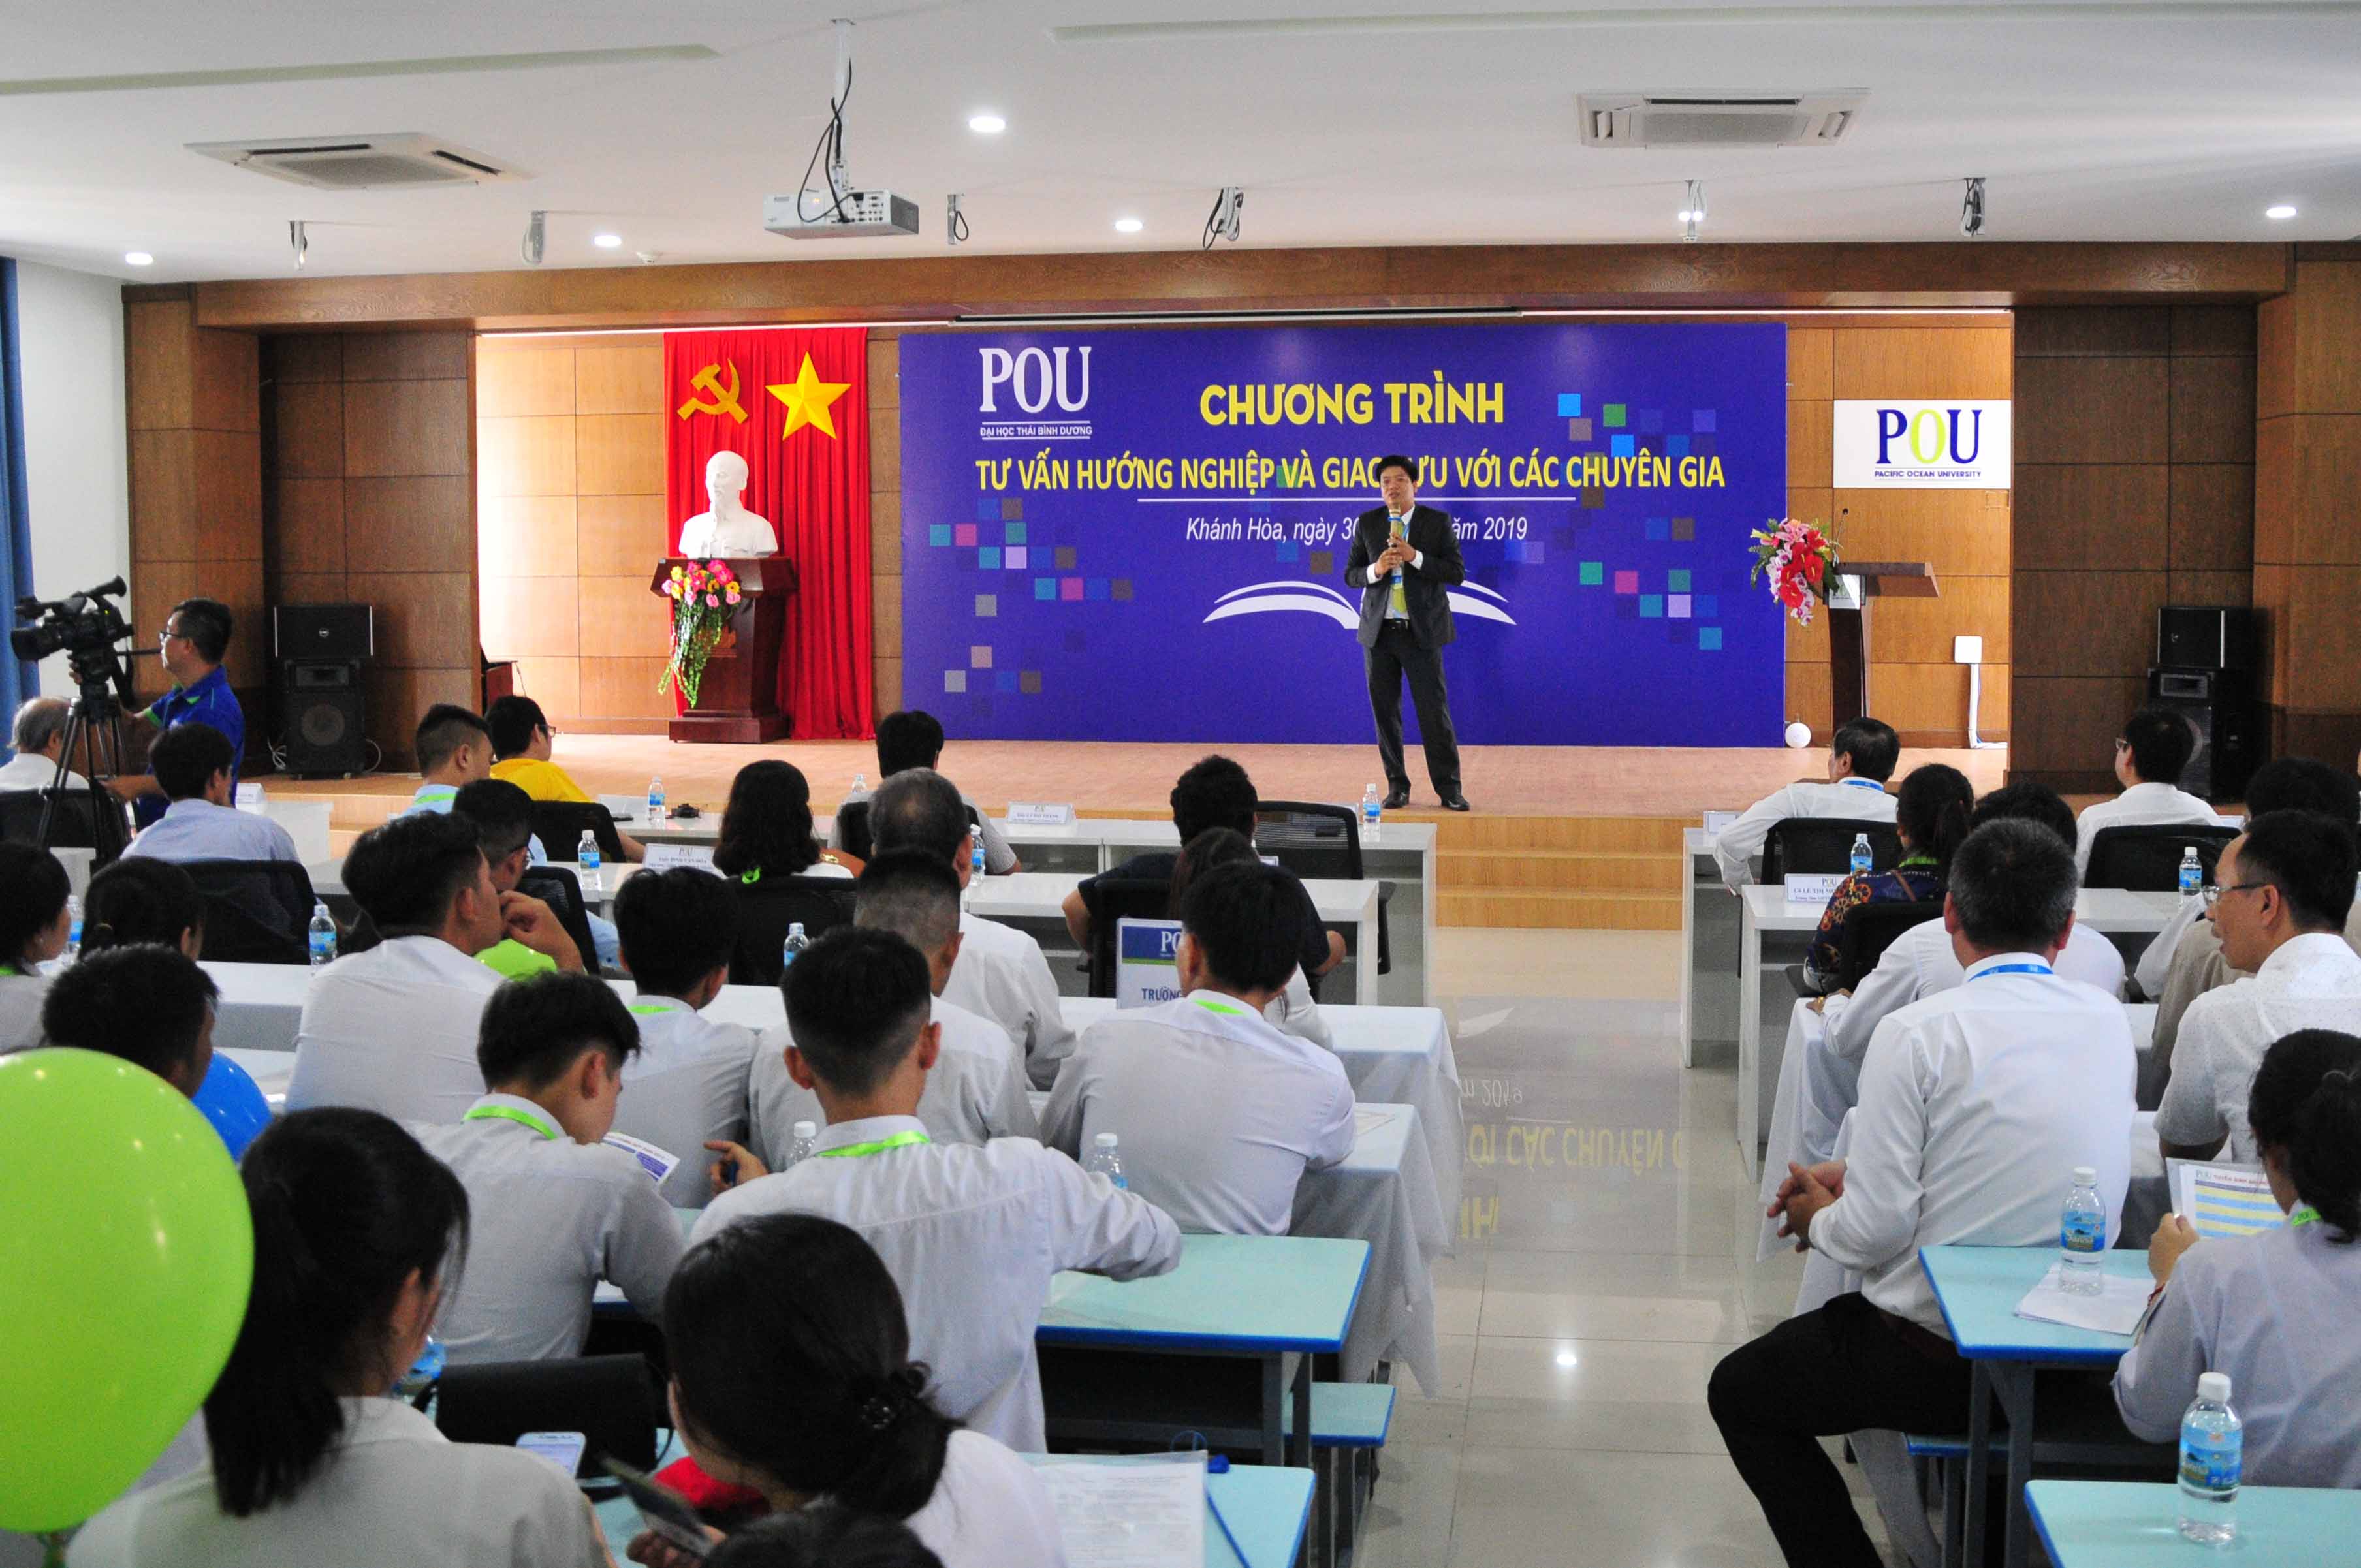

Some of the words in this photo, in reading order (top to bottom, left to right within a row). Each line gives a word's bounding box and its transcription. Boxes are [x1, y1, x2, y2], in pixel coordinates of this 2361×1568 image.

[979, 346, 1092, 413] POU
[1200, 383, 1374, 426] CHƯƠNG
[1384, 370, 1504, 424] TRÌNH
[980, 427, 994, 438] ĐẠI
[996, 427, 1015, 437] HỌC
[1017, 425, 1036, 436] THÁI
[1038, 424, 1058, 435] BÌNH
[1060, 426, 1092, 435] DƯƠNG
[1876, 409, 1982, 464] POU
[975, 458, 1012, 490] TƯ
[1018, 447, 1069, 490] VẤN
[1077, 451, 1173, 490] HƯỚNG
[1181, 450, 1275, 495] NGHIỆP
[1282, 449, 1316, 488] VÀ
[1455, 448, 1500, 488] VỚI
[1509, 448, 1559, 488] CÁC
[1566, 448, 1671, 488] CHUYÊN
[1679, 456, 1725, 488] GIA
[1186, 517, 1242, 541] Khánh
[1247, 517, 1286, 543] Hòa,
[1293, 516, 1337, 546] ngày
[1451, 517, 1478, 540] ăm
[1483, 516, 1527, 540] 2019
